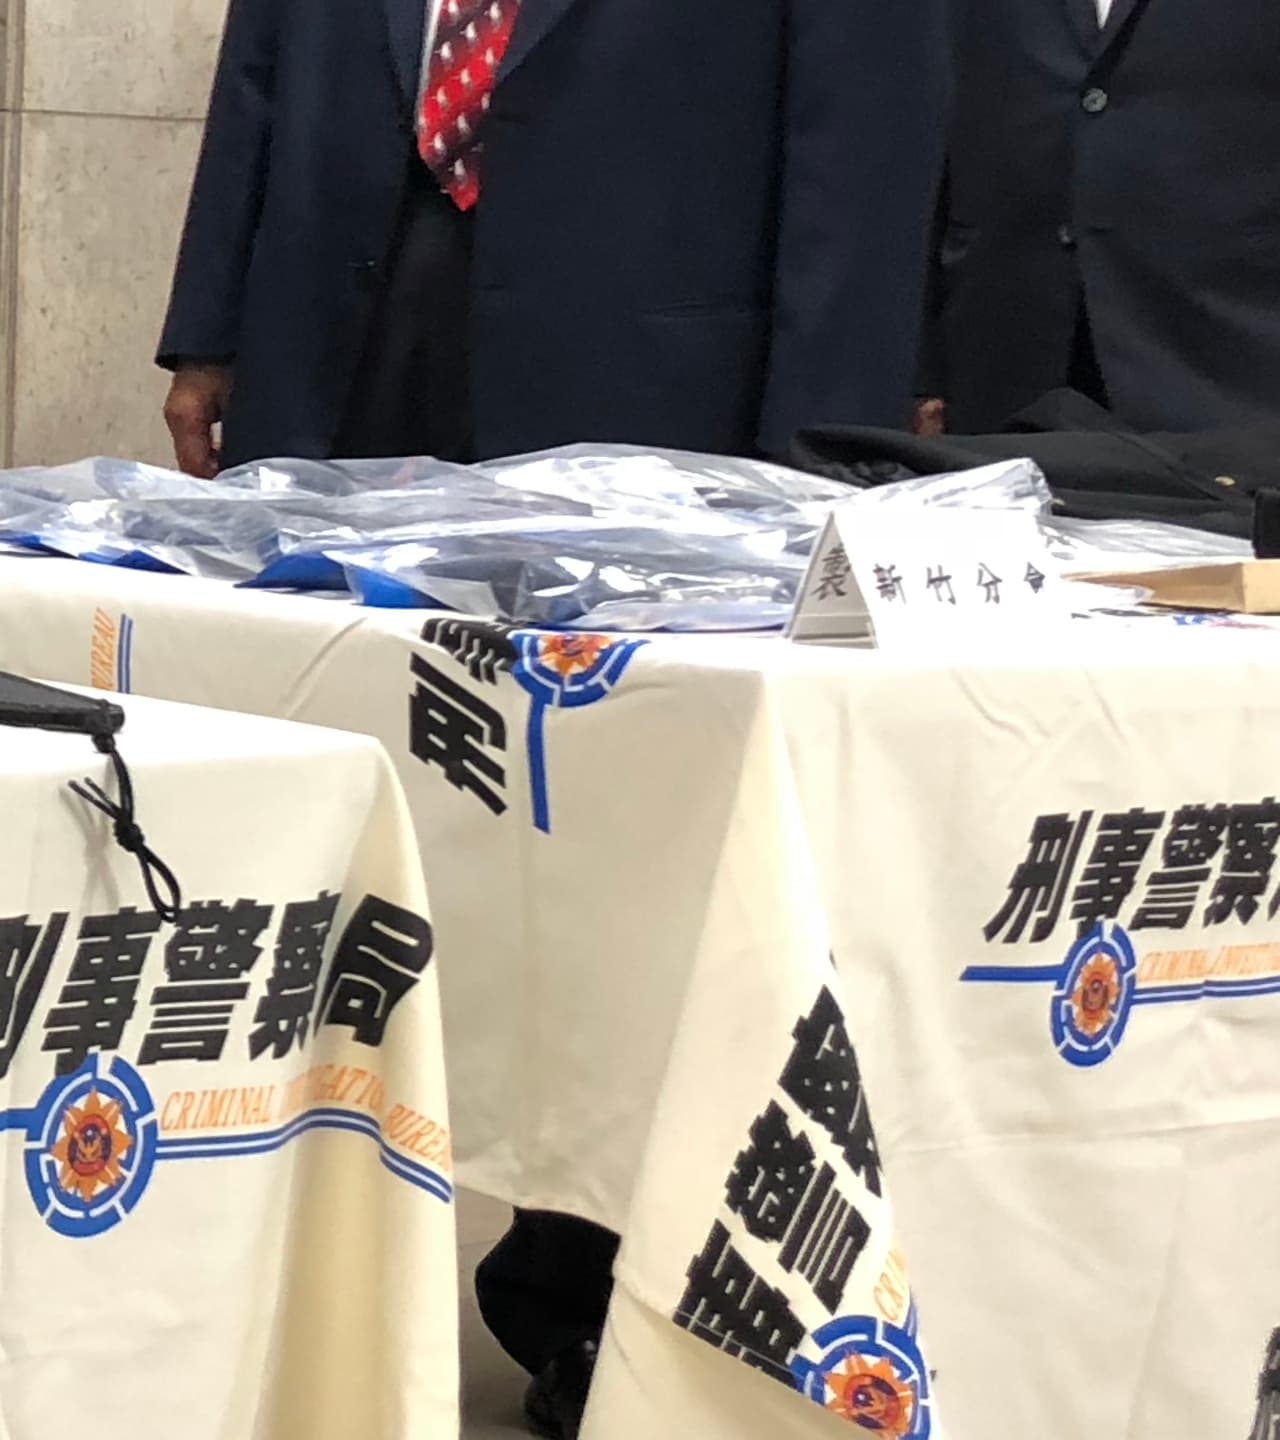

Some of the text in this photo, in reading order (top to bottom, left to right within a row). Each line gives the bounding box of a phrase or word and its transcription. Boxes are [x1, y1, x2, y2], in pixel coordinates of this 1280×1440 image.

[981, 795, 1280, 943] 刑事警察
[159, 1085, 277, 1131] CRIMINAL
